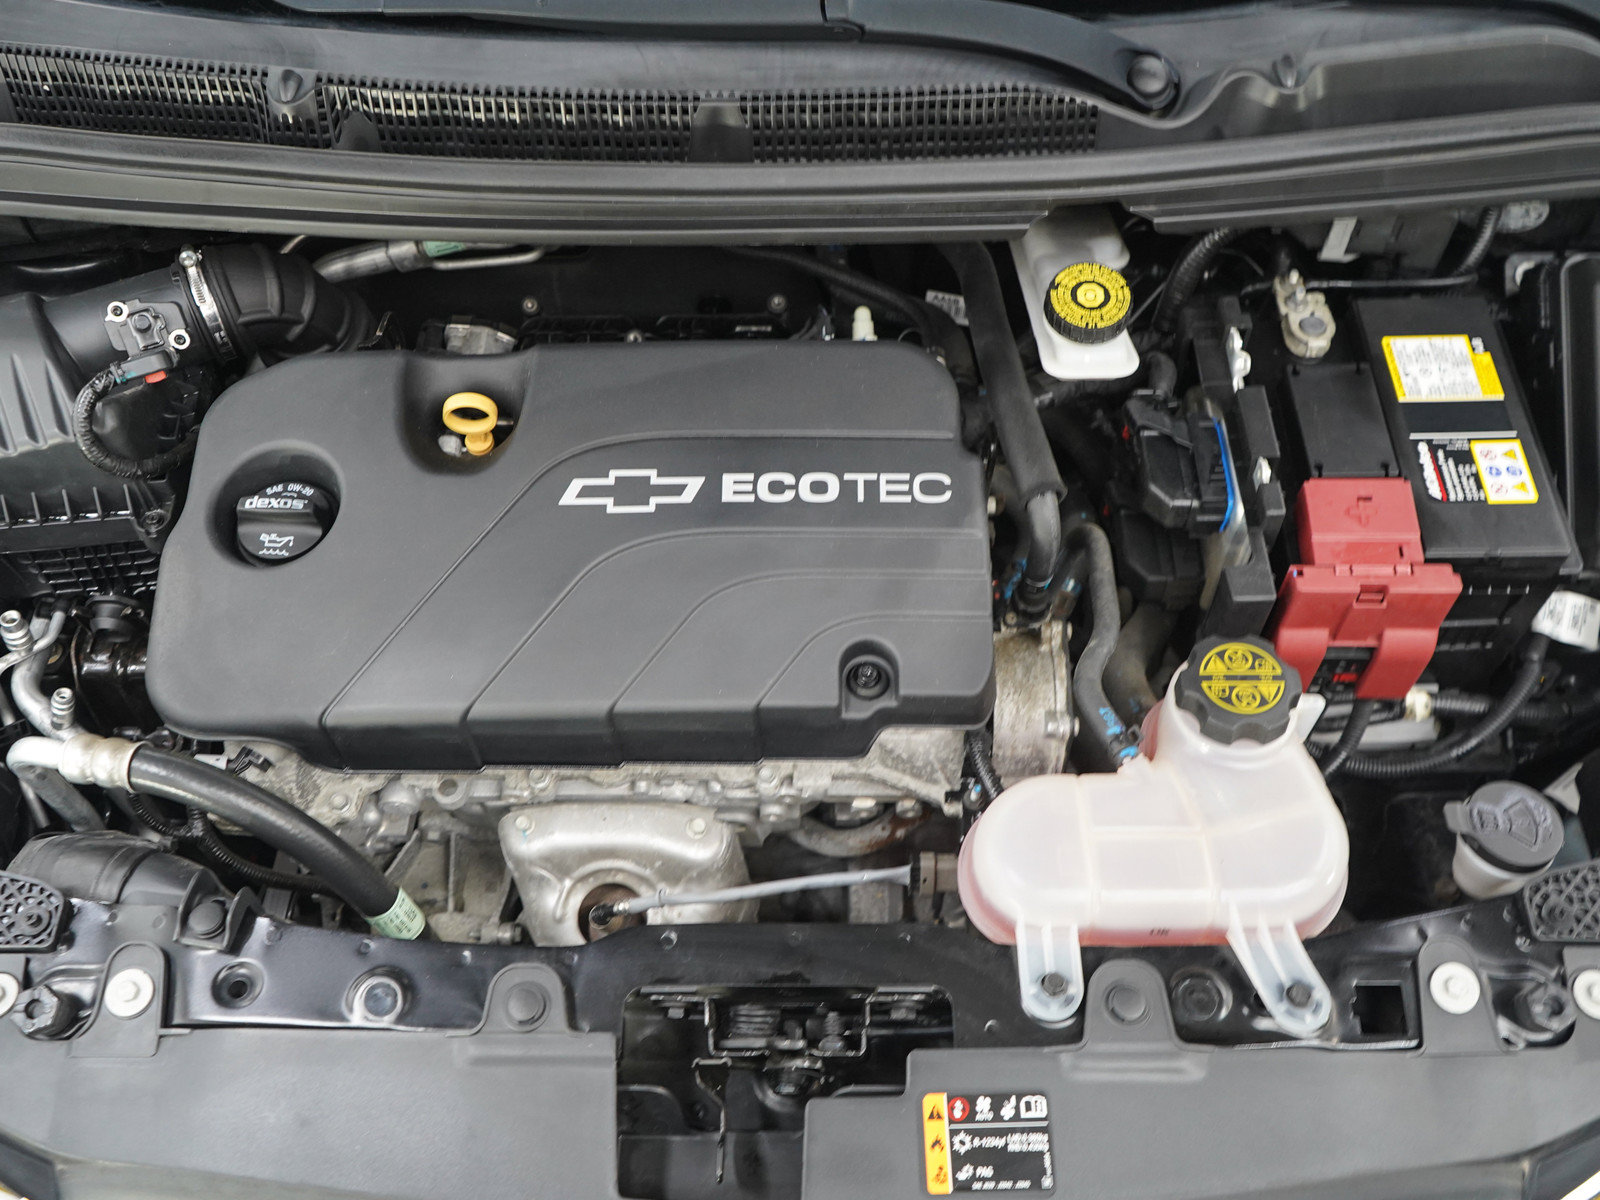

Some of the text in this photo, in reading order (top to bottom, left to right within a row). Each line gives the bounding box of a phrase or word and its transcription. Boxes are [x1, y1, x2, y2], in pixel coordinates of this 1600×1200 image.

[266, 483, 314, 496] SAE 0W-20
[721, 472, 952, 503] ECOTEC
[244, 495, 304, 509] dexos
